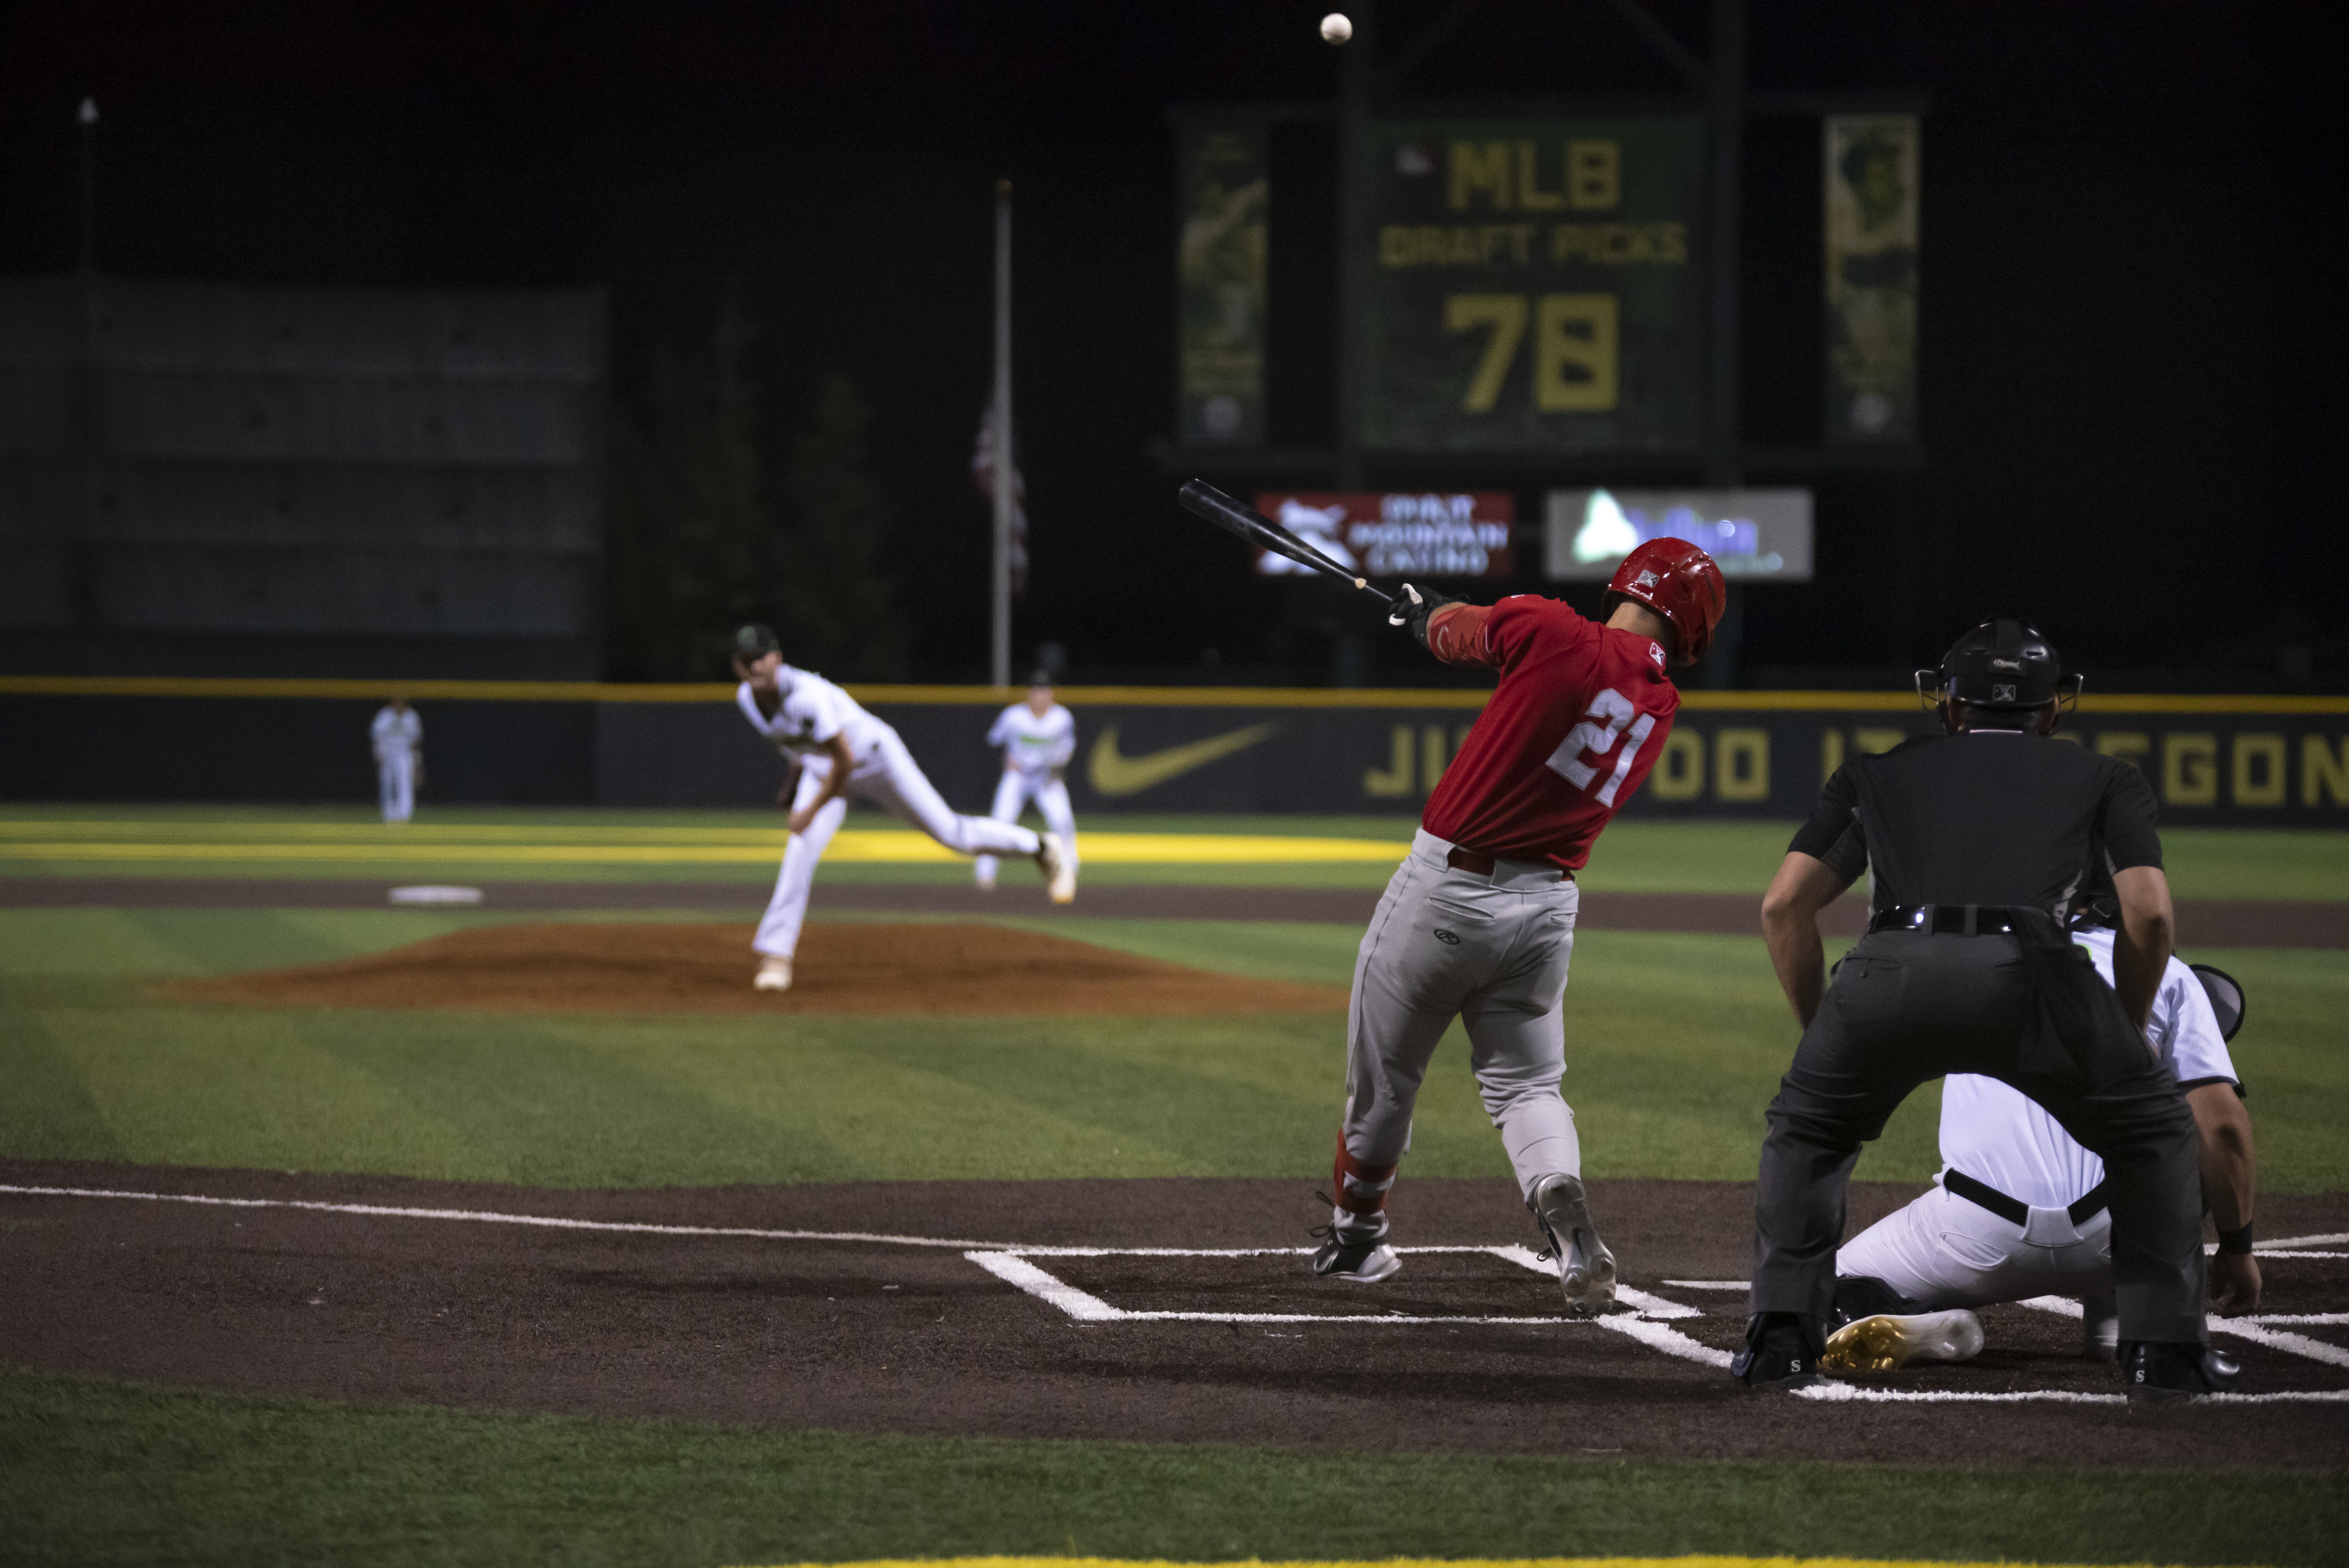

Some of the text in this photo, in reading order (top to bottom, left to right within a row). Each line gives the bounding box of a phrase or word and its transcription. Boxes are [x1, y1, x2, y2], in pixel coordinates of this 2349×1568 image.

[1448, 139, 1621, 211] MLB
[1379, 221, 1688, 266] DRAFT PICKS
[1445, 293, 1621, 412] 78
[1364, 725, 1474, 796] JU
[1545, 688, 1656, 809] 21
[1791, 1360, 1801, 1372] S
[2136, 1370, 2145, 1382] S
